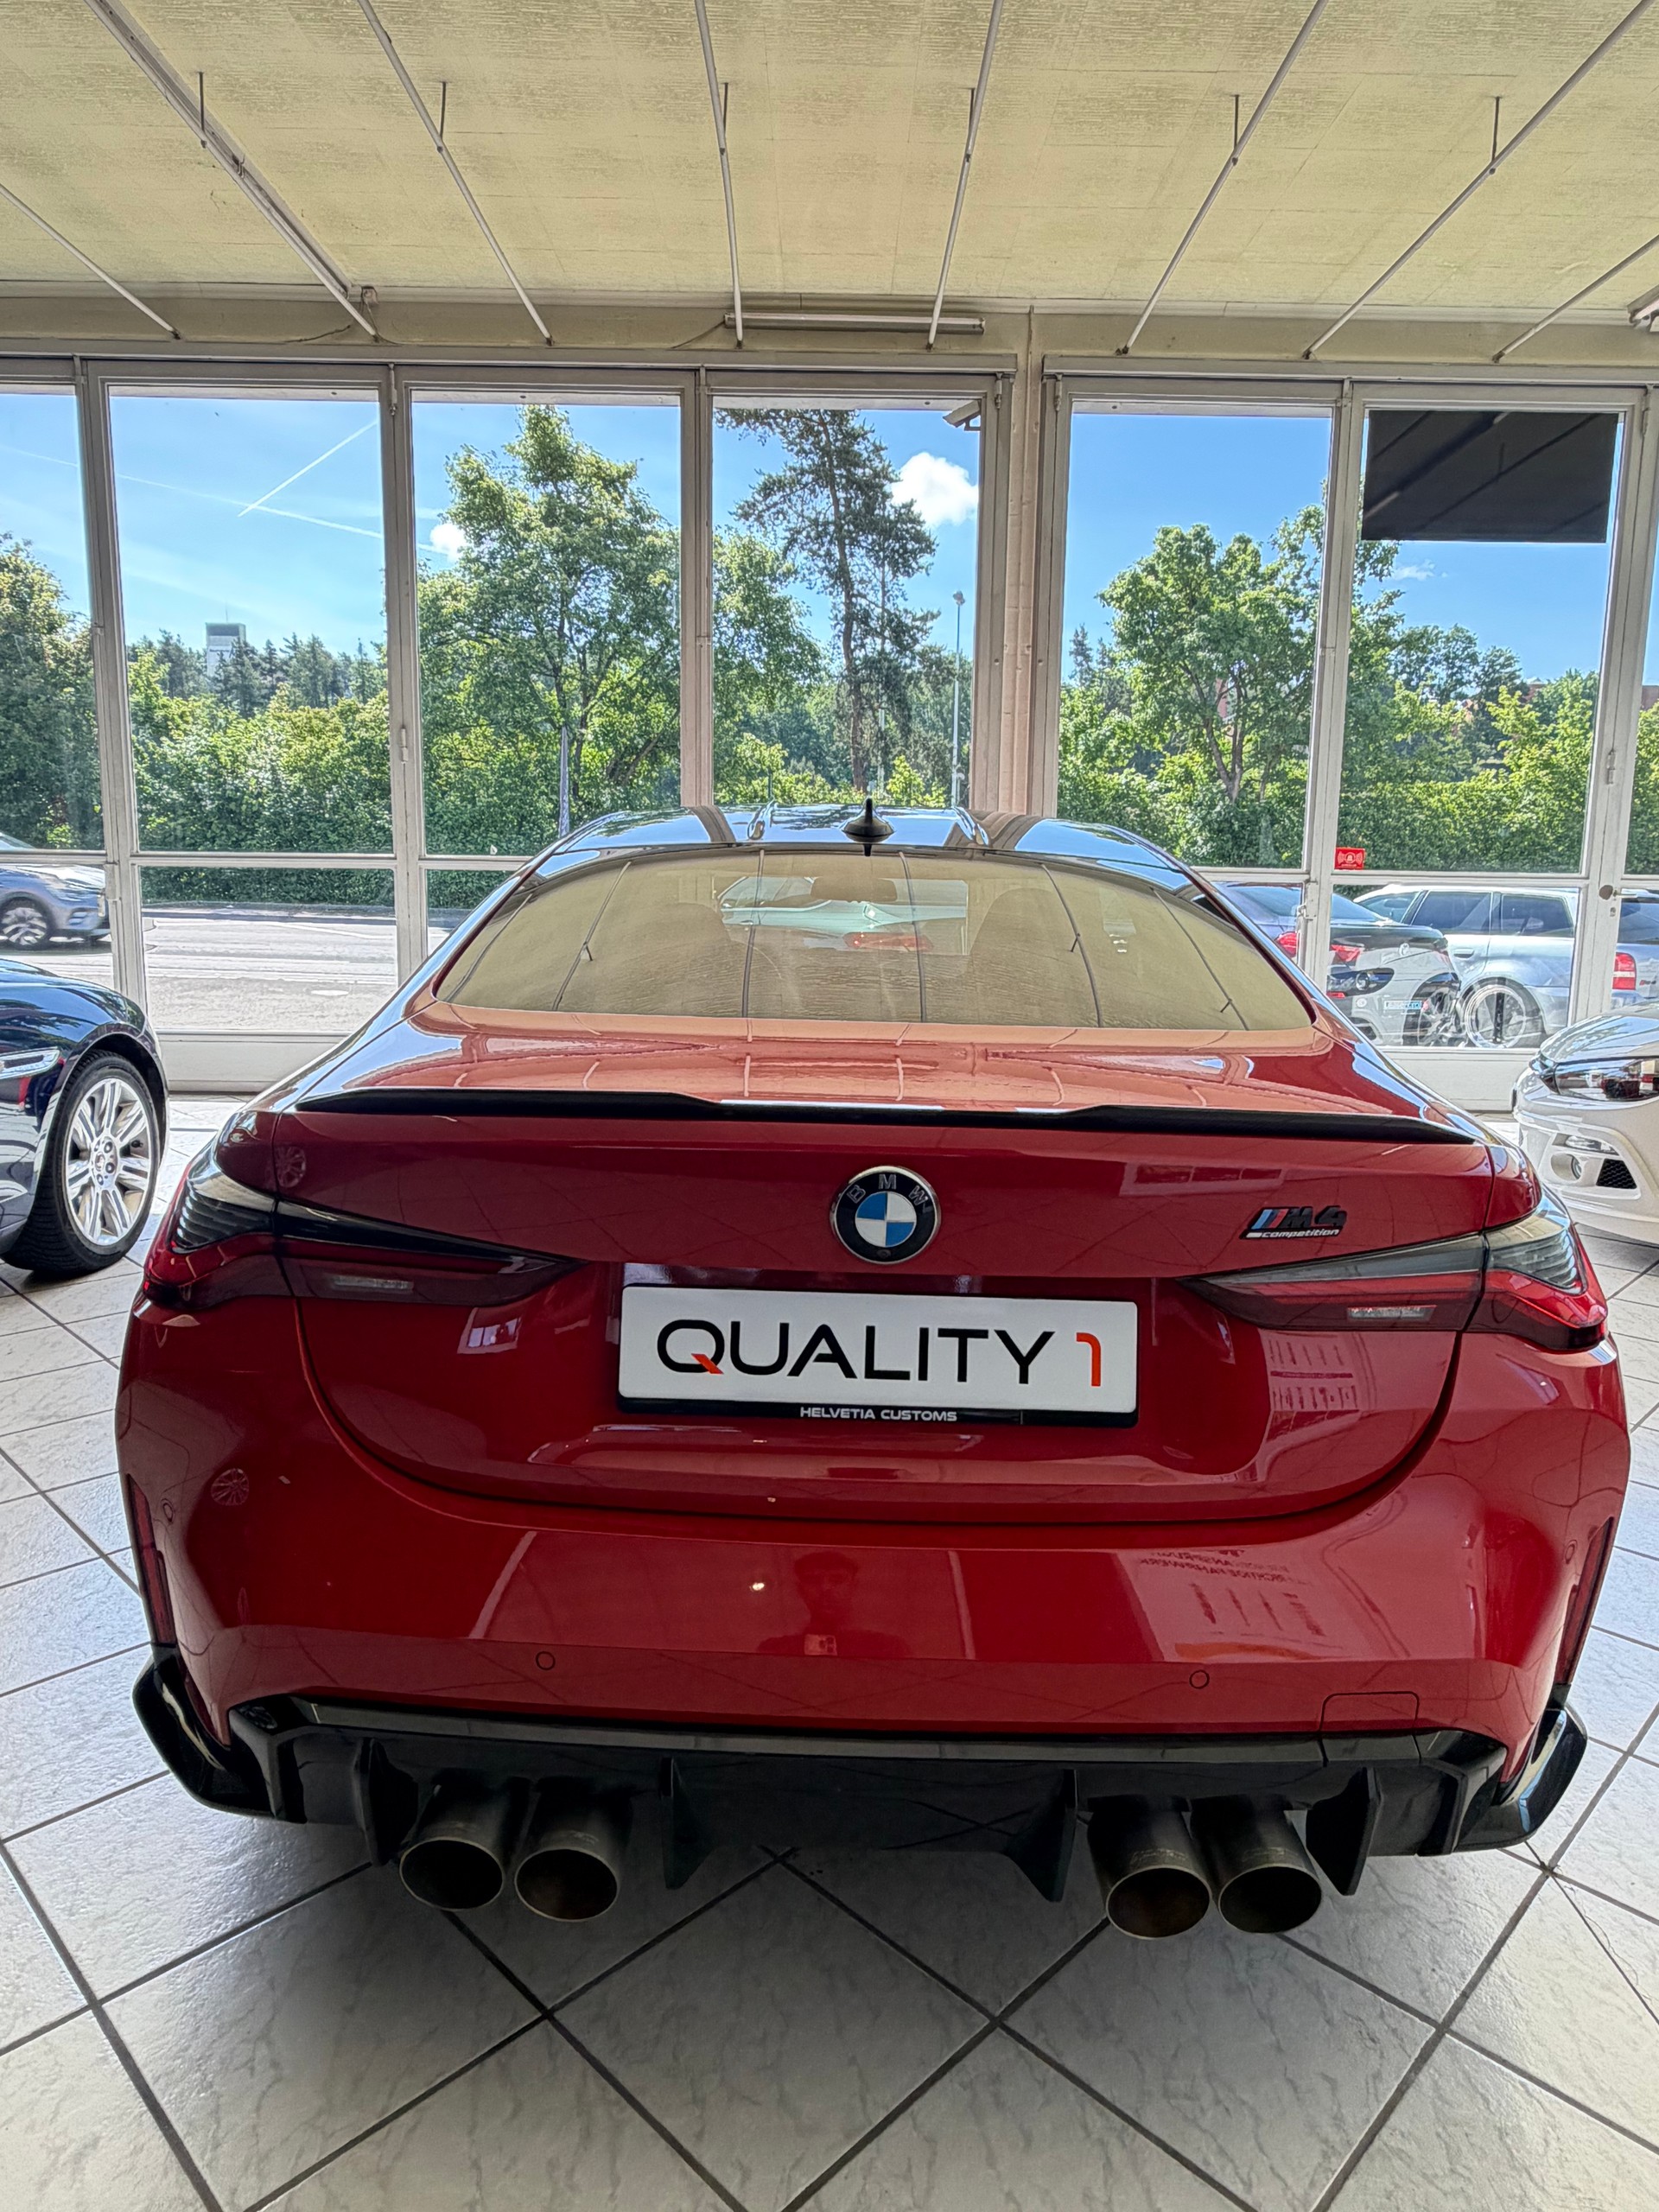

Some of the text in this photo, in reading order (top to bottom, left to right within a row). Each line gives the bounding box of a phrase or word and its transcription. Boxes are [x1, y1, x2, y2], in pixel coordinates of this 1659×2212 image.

[847, 1173, 929, 1206] BMW
[1274, 1206, 1348, 1229] M4
[1262, 1228, 1339, 1239] competition
[656, 1319, 1102, 1388] QUALITY 1
[800, 1406, 958, 1422] HELVETIA CUSTOMS
